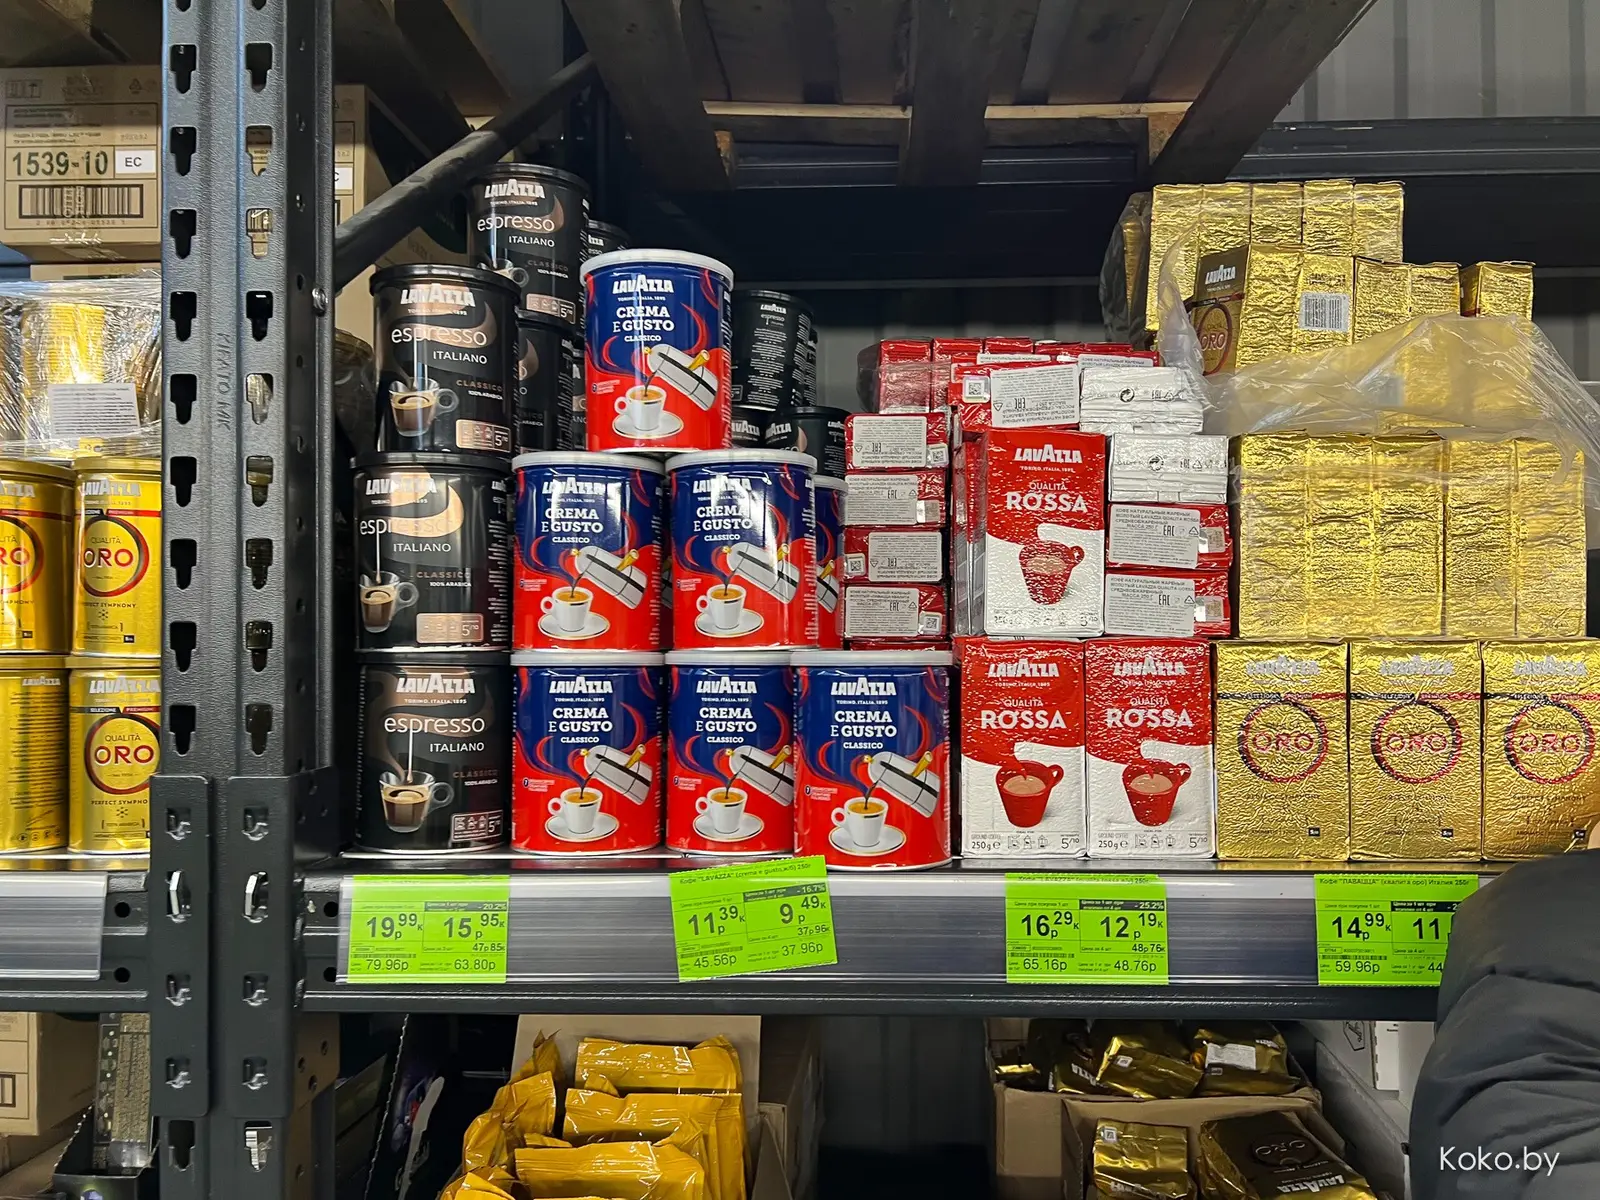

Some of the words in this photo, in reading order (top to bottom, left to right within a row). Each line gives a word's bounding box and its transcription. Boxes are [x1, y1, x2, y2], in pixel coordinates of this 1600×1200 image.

[12, 150, 109, 177] 1539-10
[125, 157, 142, 167] EC
[484, 179, 545, 199] LAVAZZA
[477, 214, 555, 232] espresso
[509, 235, 555, 248] ITALIANO
[528, 260, 569, 272] CLASSICO
[1205, 264, 1236, 285] LAVAZZA
[613, 275, 674, 294] LAVAZZA
[400, 283, 475, 307] LAVAZZA
[616, 306, 670, 318] CREMA
[760, 303, 787, 314] LAVAZZA
[613, 321, 621, 333] E
[622, 319, 675, 332] GUSTO
[391, 326, 487, 345] espresso
[1201, 333, 1227, 351] ORO
[433, 350, 488, 365] ITALIANO
[456, 379, 502, 392] CLASSICO
[1014, 444, 1083, 464] LAVAZZA
[1029, 481, 1067, 491] QUALITÀ
[1006, 492, 1088, 513] ROSSA
[545, 508, 599, 520] CREMA
[696, 505, 749, 518] CREMA
[541, 521, 549, 533] E
[551, 521, 603, 533] GUSTO
[693, 520, 701, 532] E
[702, 519, 753, 531] GUSTO
[90, 535, 122, 544] QUALITÀ
[552, 536, 590, 544] CLASSICO
[704, 534, 741, 542] CLASSICO
[393, 543, 452, 553] ITALIANO
[84, 548, 134, 568] ORO
[416, 571, 471, 579] CLASSICO
[988, 659, 1060, 678] LAVAZZA
[1113, 658, 1187, 676] LAVAZZA
[22, 676, 61, 686] LAVAZZA
[89, 676, 161, 694] LAVAZZA
[396, 674, 475, 694] LAVAZZA
[549, 676, 613, 694] LAVAZZA
[696, 676, 757, 694] LAVAZZA
[830, 677, 897, 696] LAVAZZA
[1003, 697, 1044, 707] QUALITÀ
[552, 707, 609, 719] CREMA
[699, 707, 752, 719] CREMA
[834, 710, 892, 723] CREMA
[980, 709, 1067, 729] ROSSA
[1106, 708, 1193, 728] ROSSA
[384, 717, 485, 733] espresso
[548, 721, 557, 732] E
[559, 720, 613, 733] GUSTO
[695, 720, 704, 732] E
[705, 720, 757, 732] GUSTO
[830, 725, 839, 737] E
[840, 725, 897, 738] GUSTO
[105, 733, 141, 742] QUALITÀ
[560, 736, 600, 744] CLASSICO
[843, 741, 884, 749] CLASSICO
[1252, 733, 1315, 751] ORO
[1385, 733, 1448, 752] ORO
[1519, 733, 1581, 753] ORO
[94, 745, 154, 765] ORO
[430, 742, 485, 753] ITALIANO
[1061, 837, 1080, 849] 5/10
[1189, 837, 1208, 848] 5/10
[779, 903, 794, 924] 9
[366, 916, 395, 938] 19
[443, 917, 471, 938] 15
[688, 912, 715, 936] 11
[1021, 914, 1050, 937] 16
[1100, 917, 1129, 938] 12
[1332, 916, 1361, 938] 14
[1412, 917, 1439, 939] 11
[781, 942, 823, 957] 37.96р
[366, 959, 409, 972] 79.96р
[454, 959, 496, 972] 63.80р
[694, 954, 737, 969] 45.56р
[1023, 958, 1067, 972] 65.16р
[1114, 960, 1156, 973] 48.76р
[1335, 961, 1380, 973] 59.96р
[1255, 1139, 1306, 1155] ORO
[1277, 1174, 1345, 1193] LAVAZZA
